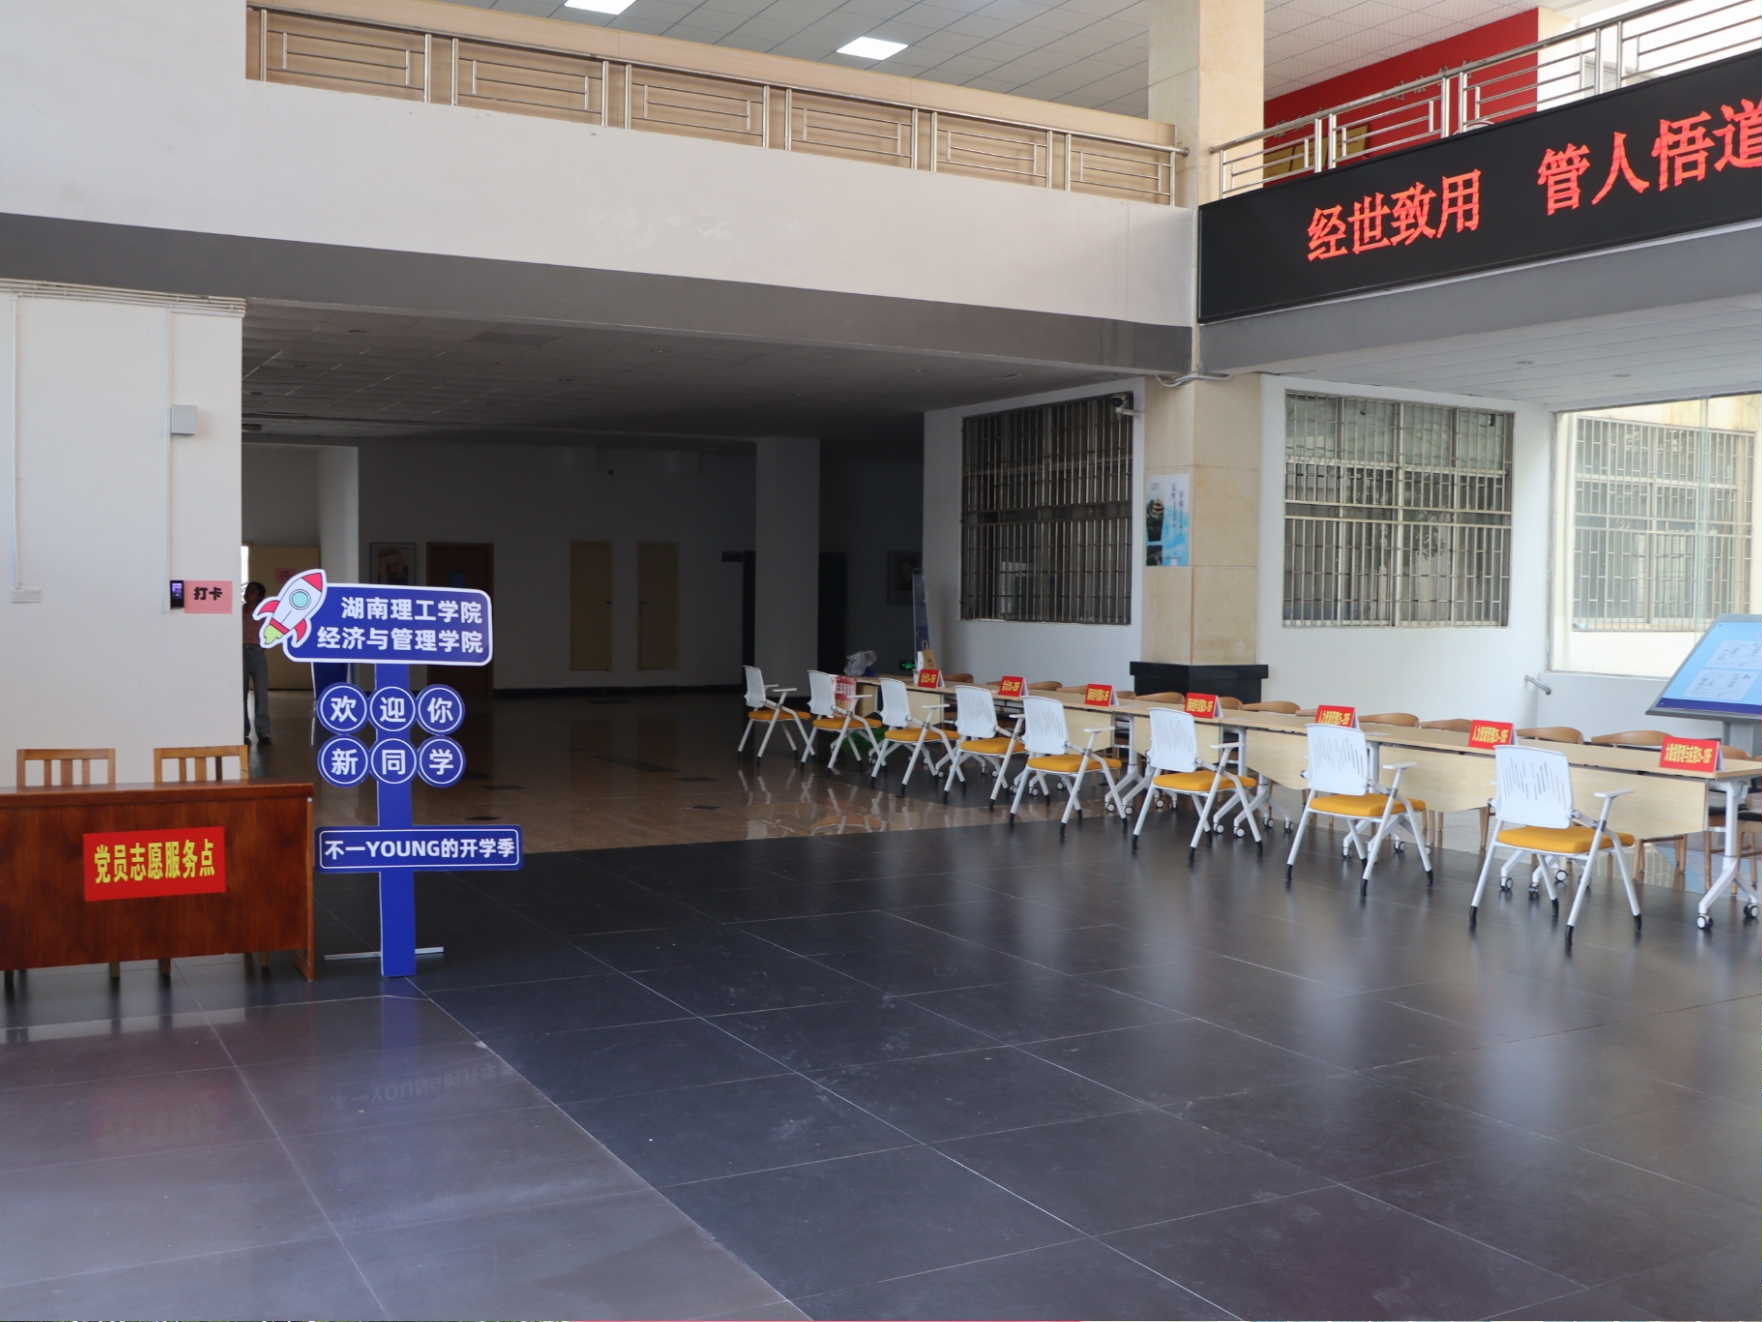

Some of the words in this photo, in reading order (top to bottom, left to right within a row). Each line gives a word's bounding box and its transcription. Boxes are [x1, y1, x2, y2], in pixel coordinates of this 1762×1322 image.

[1307, 168, 1482, 262] 经世致用
[1538, 98, 1762, 216] 管人悟道
[193, 586, 223, 601] 打卡
[341, 596, 483, 624] 湖南理工学院
[317, 626, 484, 654] 经济与管理学院
[330, 695, 454, 724] 欢迎你
[331, 749, 454, 776] 新同学
[94, 838, 215, 884] 党员志愿服务点
[324, 837, 516, 861] 不一YOUNG的开学季
